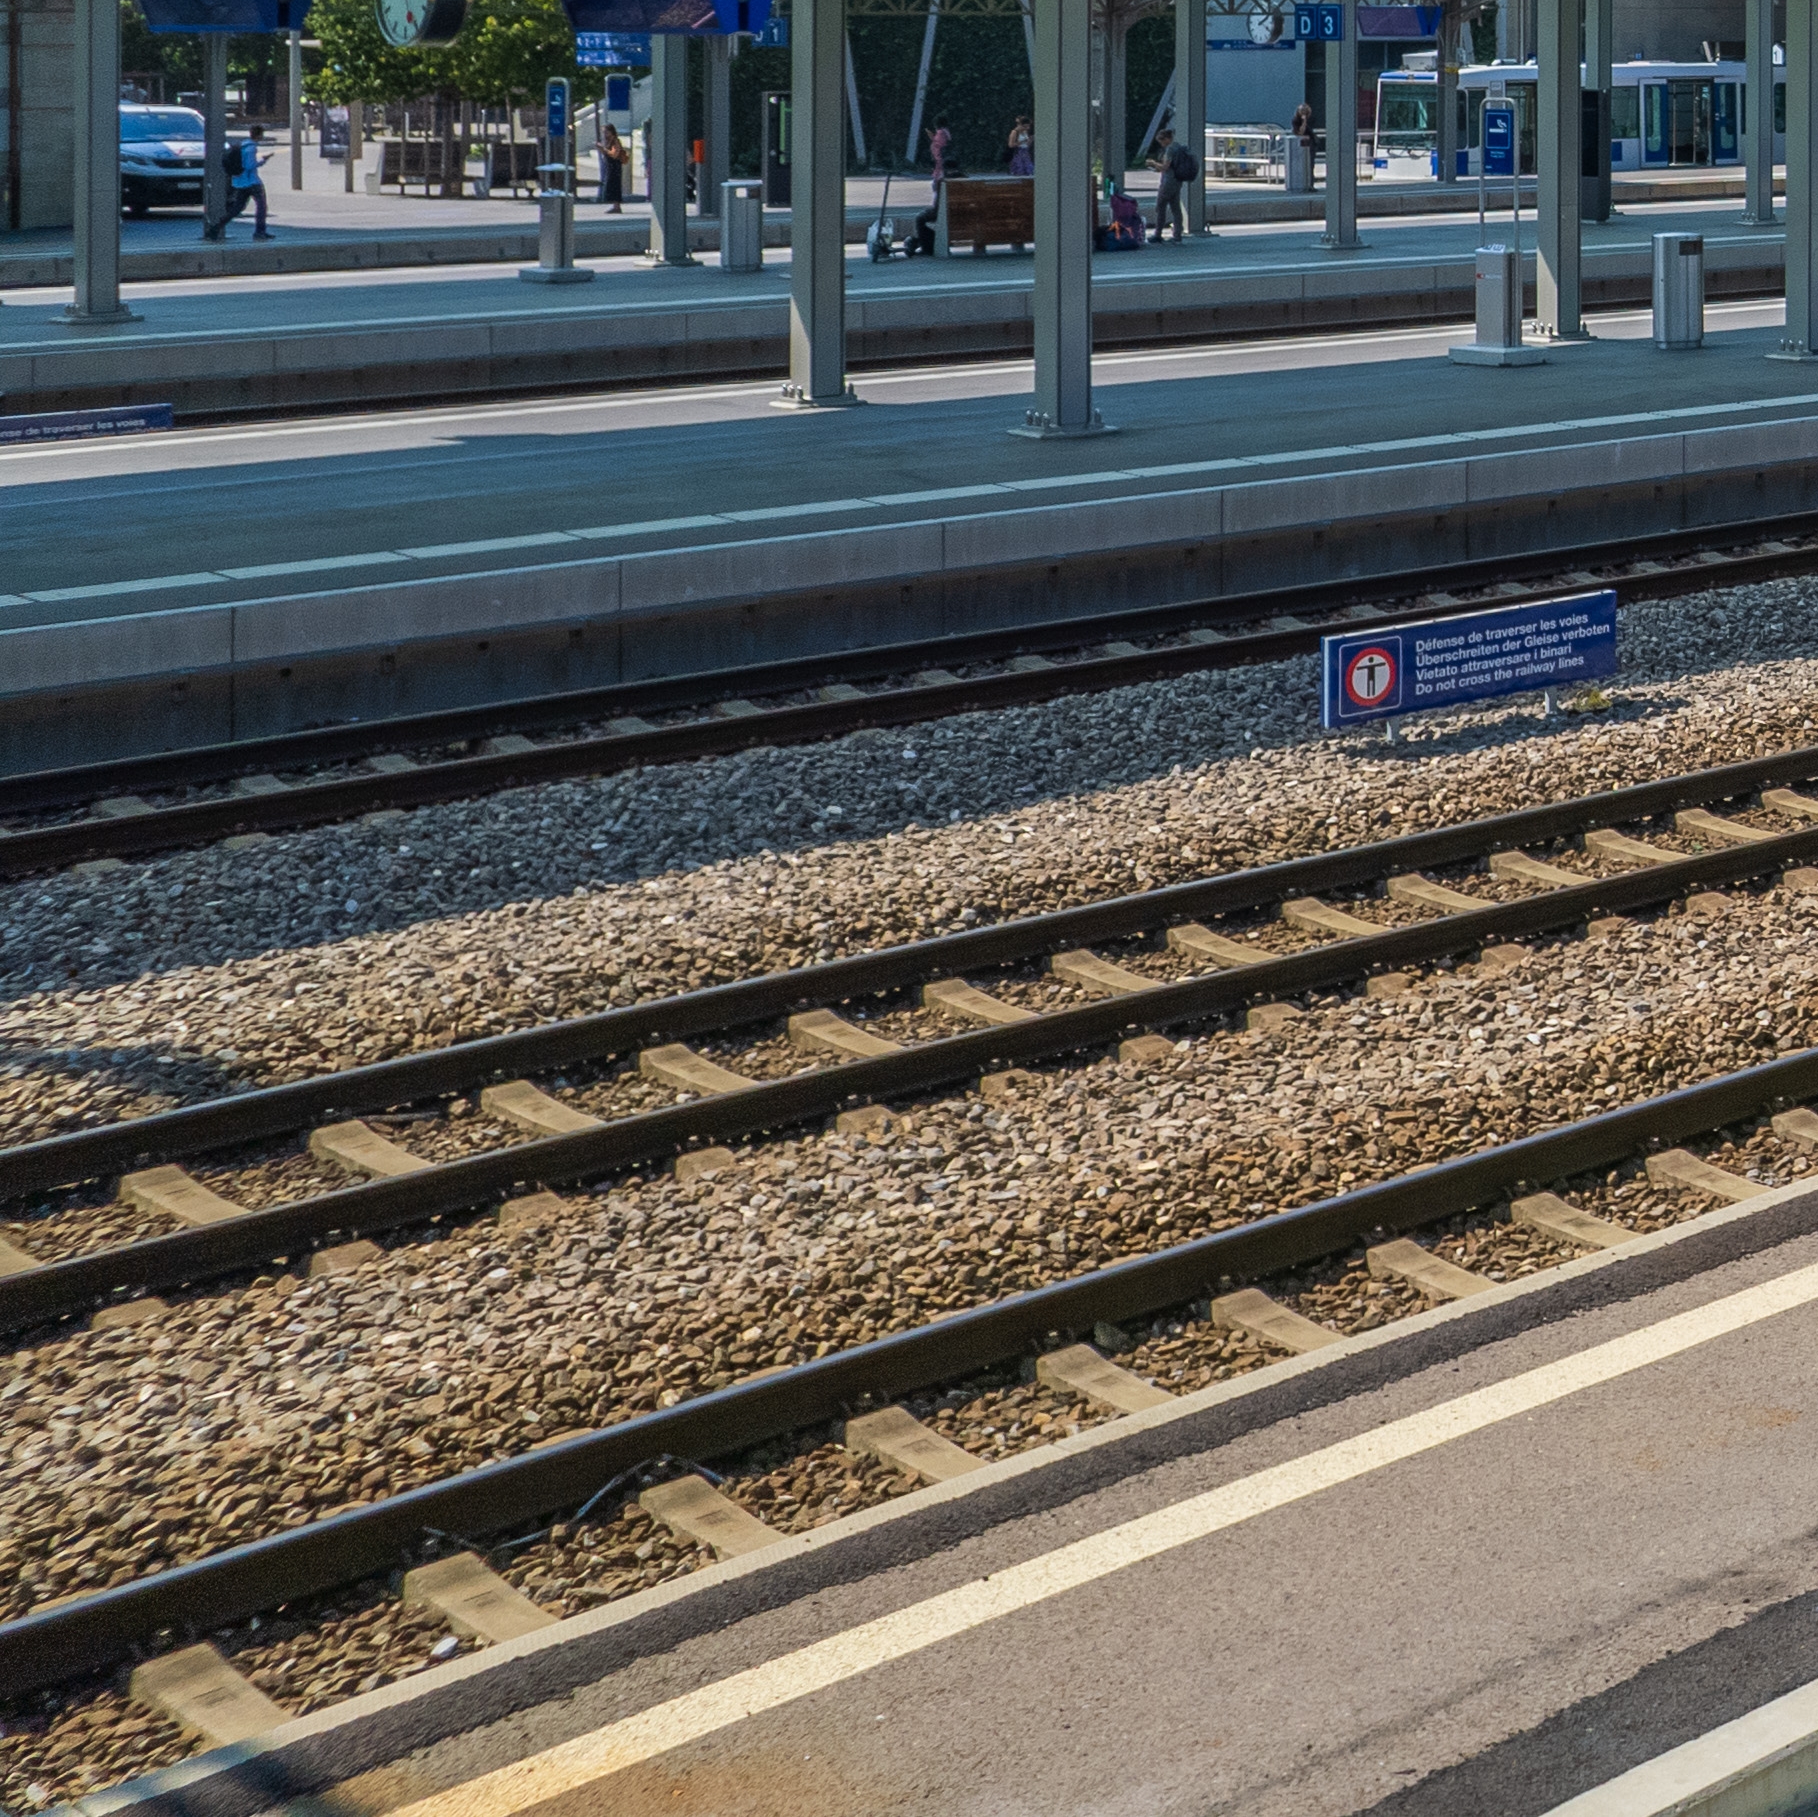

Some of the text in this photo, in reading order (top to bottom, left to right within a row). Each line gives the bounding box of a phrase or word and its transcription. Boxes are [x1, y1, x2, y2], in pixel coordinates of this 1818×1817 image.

[1301, 16, 1333, 35] D 3
[1416, 613, 1588, 652] Défense de traverser les voies
[1416, 624, 1610, 667] Überschreiten der Gleise verboten
[1415, 655, 1584, 695] Do not cross the railway lines
[1416, 665, 1458, 681] Vietato
[1461, 652, 1531, 673] attraversare
[1540, 642, 1572, 659] binari
